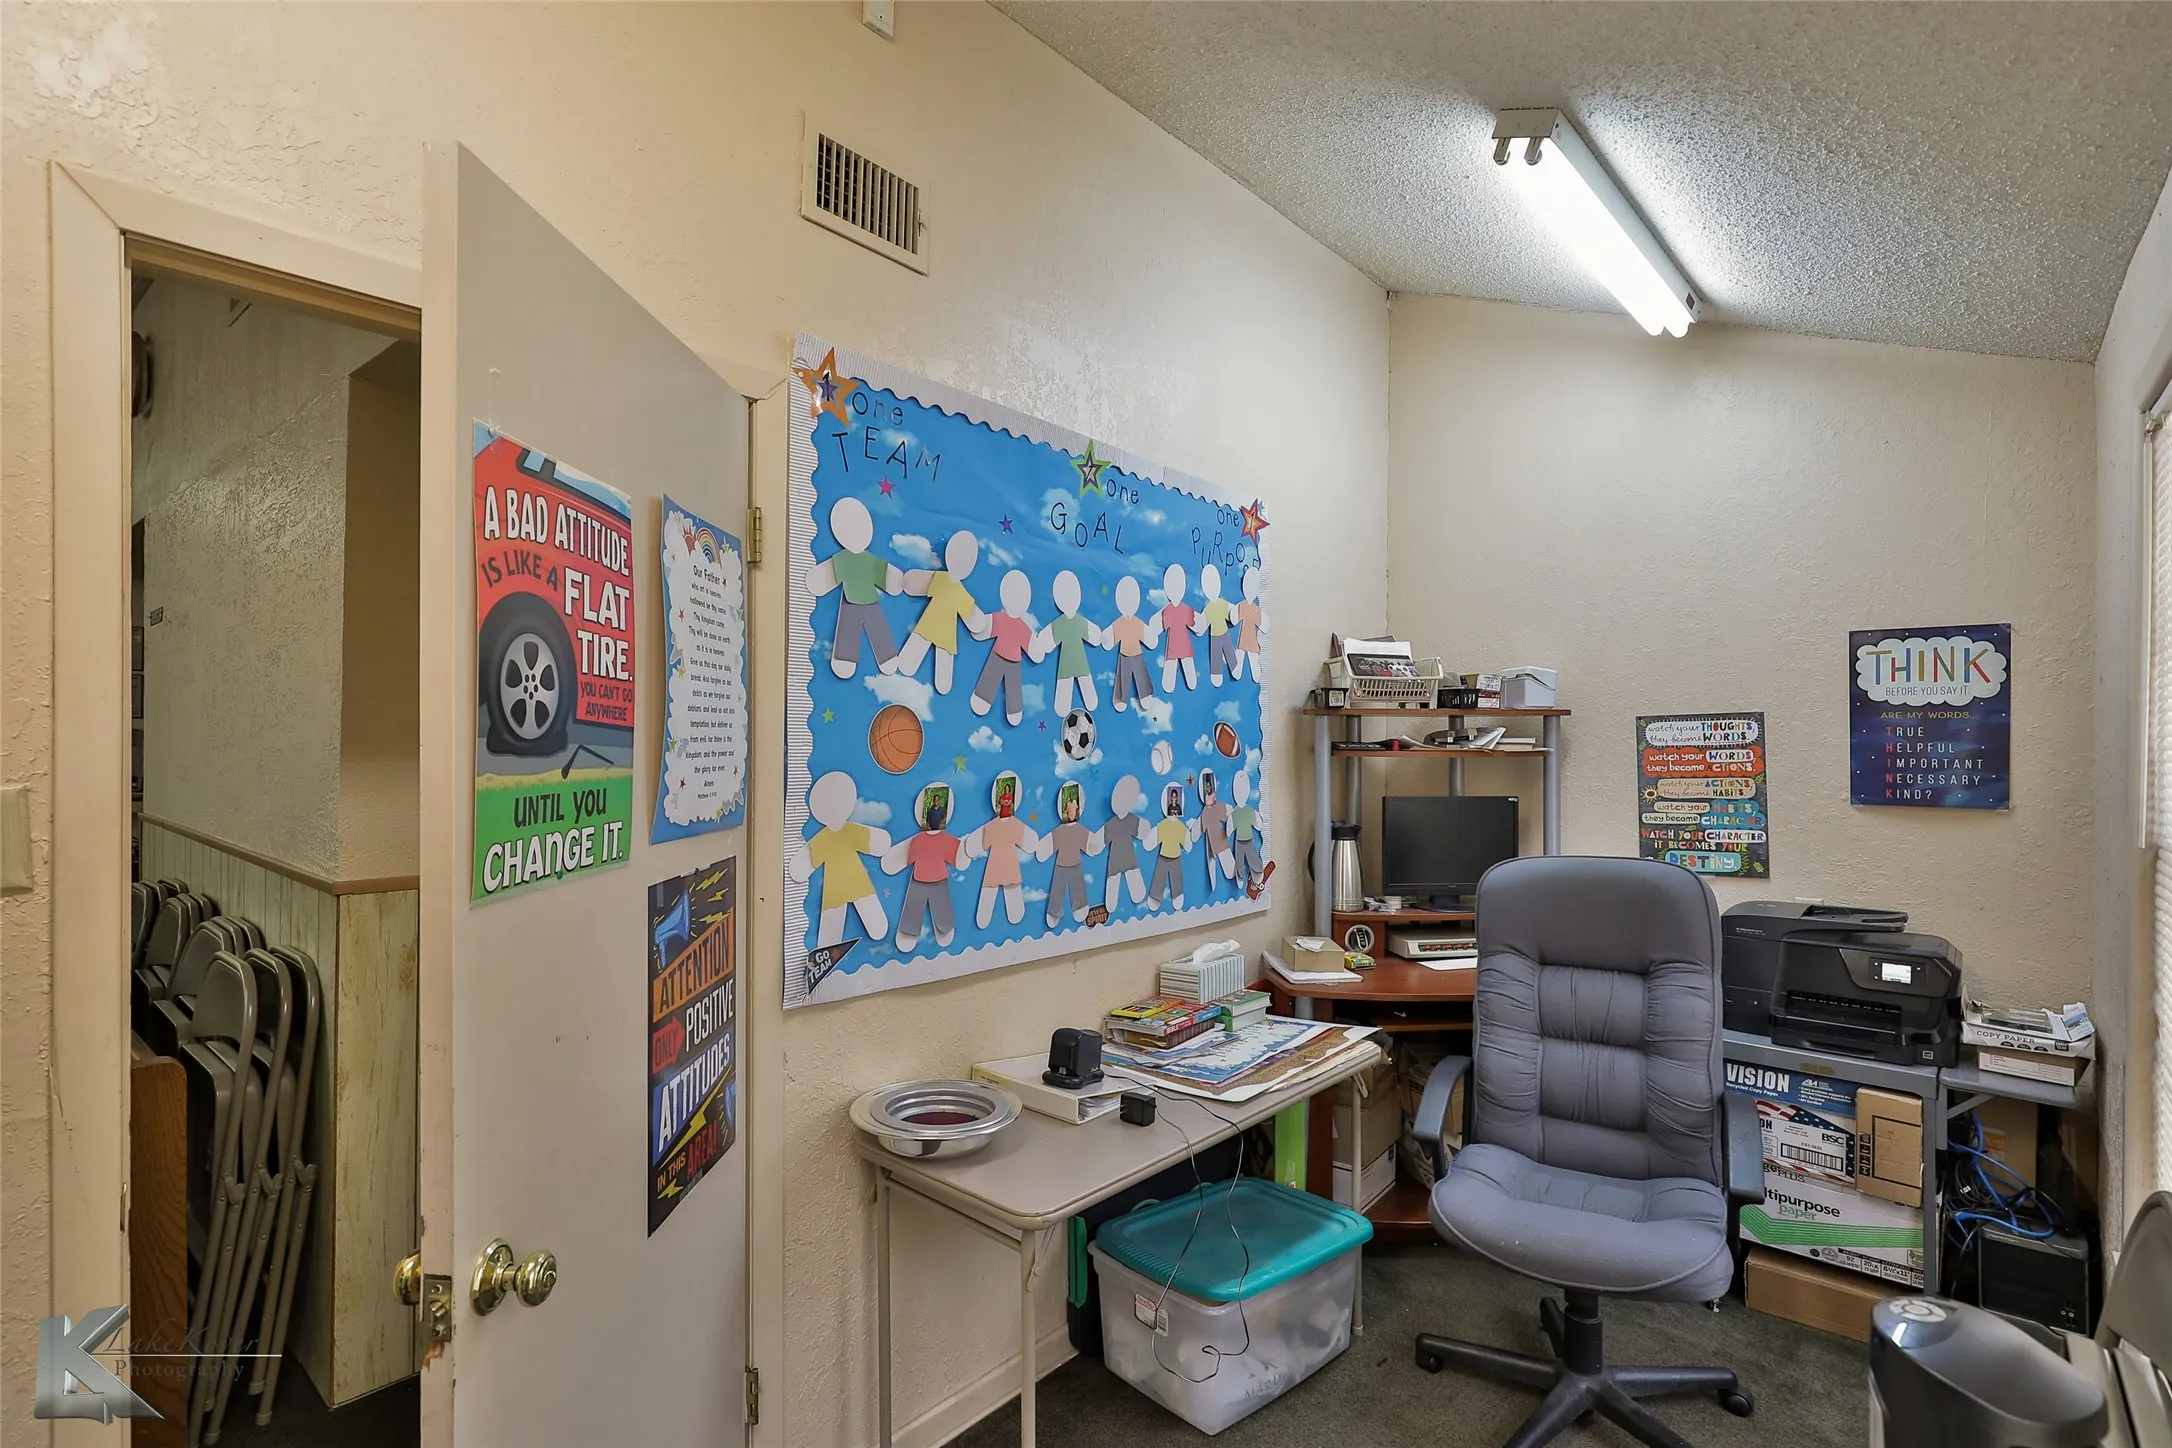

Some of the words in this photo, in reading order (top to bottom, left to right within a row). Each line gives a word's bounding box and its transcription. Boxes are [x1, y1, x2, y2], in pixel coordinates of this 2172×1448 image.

[831, 425, 941, 482] TEAM
[483, 485, 502, 541] A
[506, 488, 549, 543] BAD
[554, 501, 629, 577] ATTITUDE
[1051, 501, 1124, 555] GOAL
[481, 562, 503, 589] IS
[503, 549, 543, 580] LIKE
[546, 568, 560, 592] A
[564, 566, 630, 631] FLAT
[577, 629, 634, 682] TIRE.
[1866, 646, 1992, 686] THINK
[580, 680, 597, 699] YOU
[599, 684, 620, 701] CAN'T
[622, 688, 634, 702] GO
[1885, 686, 1918, 697] BEFORE
[1921, 686, 1938, 696] YOU
[1940, 686, 1958, 696] SAY
[585, 704, 628, 722] ANYWHERE
[1648, 723, 1676, 732] watch
[1886, 726, 1925, 737] TRUE
[1650, 735, 1669, 745] they
[1886, 743, 1955, 753] HELPFUL
[1646, 764, 1668, 773] they
[1669, 760, 1705, 771] become
[1649, 753, 1679, 761] watch
[1681, 753, 1704, 762] your
[1886, 758, 1984, 770] IMPORTANT
[1886, 774, 1981, 786] NECESSARY
[1886, 790, 1932, 800] KIND?
[514, 792, 565, 828] UNTIL
[573, 788, 607, 819] YOU
[1687, 804, 1708, 812] your
[1644, 815, 1667, 823] they
[1665, 812, 1699, 823] become
[601, 821, 624, 860] IT.
[1642, 829, 1675, 840] WATCH
[1678, 830, 1705, 841] YOUR
[1668, 840, 1717, 850] BECOMES
[1722, 842, 1748, 852] YOUR
[815, 950, 830, 963] GO
[659, 924, 731, 1015] ATTENTION
[809, 959, 833, 984] TEAM
[654, 1029, 679, 1068] ONLY
[685, 978, 734, 1052] POSITIVE
[1976, 1029, 2001, 1039] COPY
[2004, 1033, 2036, 1045] PAPER
[1726, 1062, 1790, 1094] VISION
[658, 1034, 731, 1154] ATTITUDES
[1725, 1082, 1749, 1092] Recycled
[1749, 1087, 1762, 1095] Copy
[1763, 1089, 1778, 1097] Paper
[1822, 1133, 1845, 1146] BSC
[657, 1171, 666, 1192] IN
[668, 1152, 686, 1181] THIS
[686, 1121, 718, 1182] AREA!
[1764, 1186, 1841, 1218] ltipurpose
[1776, 1203, 1817, 1222] paper
